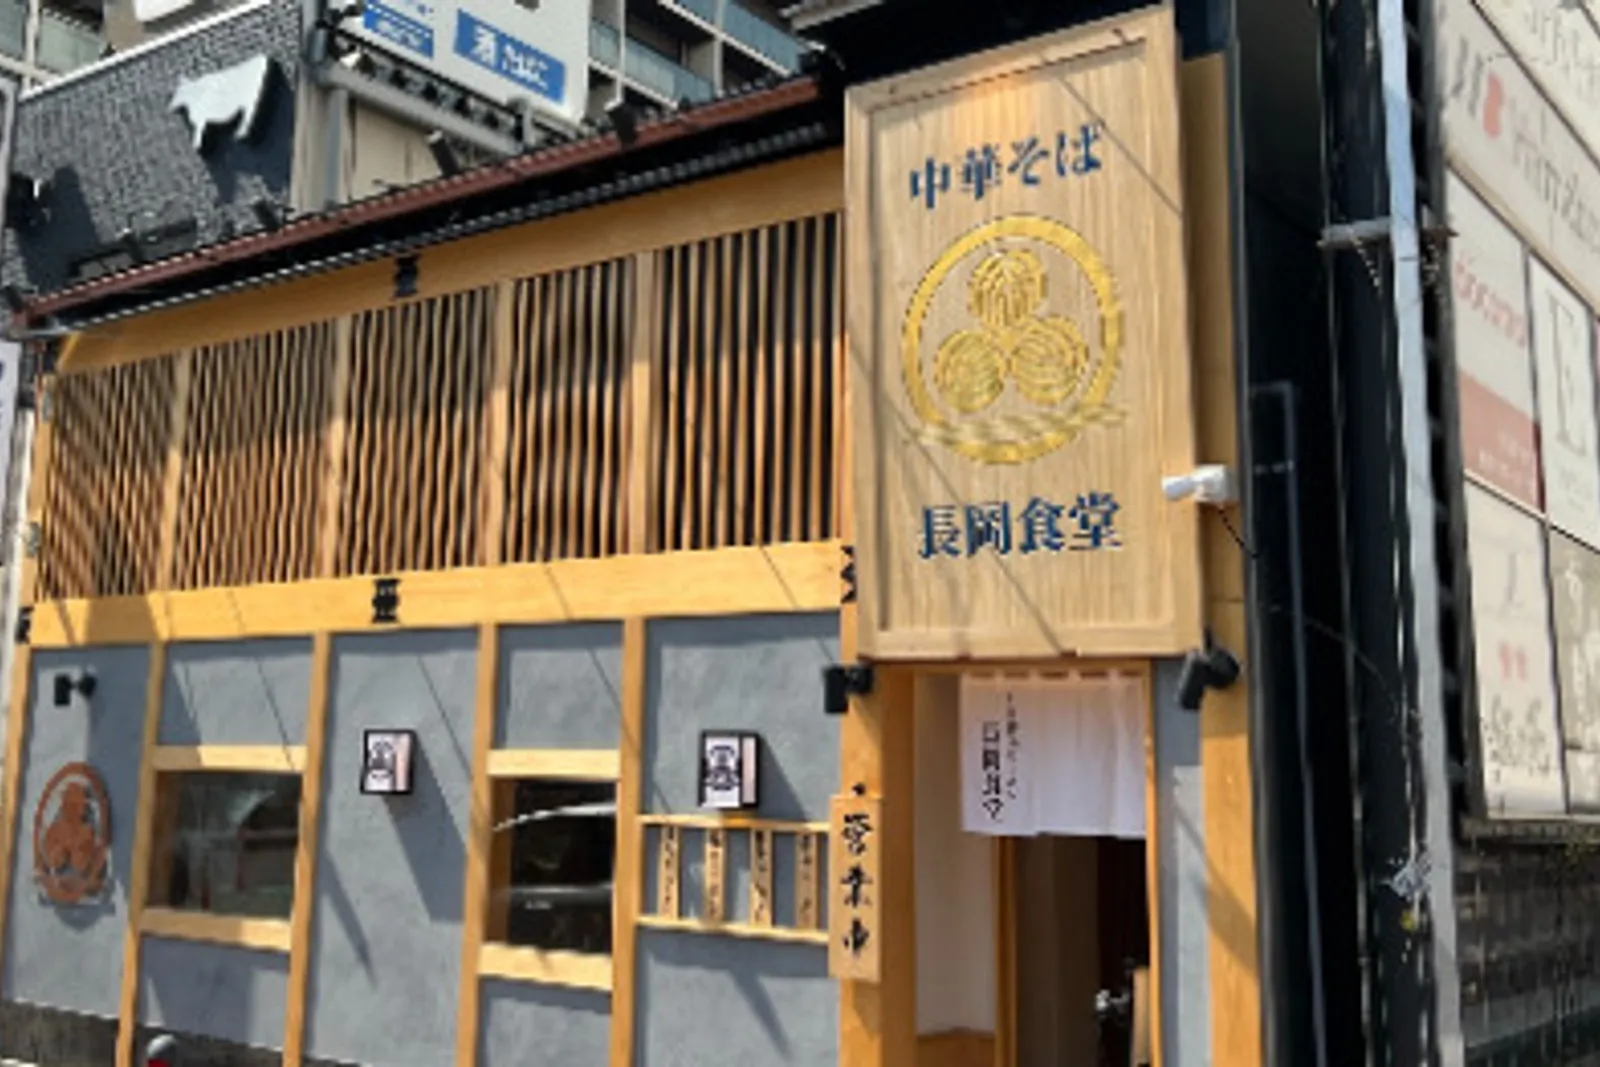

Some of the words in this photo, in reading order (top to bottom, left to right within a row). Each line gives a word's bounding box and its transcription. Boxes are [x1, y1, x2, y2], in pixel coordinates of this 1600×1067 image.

[909, 123, 1102, 210] 中華そば
[917, 491, 1123, 559] 長岡食堂
